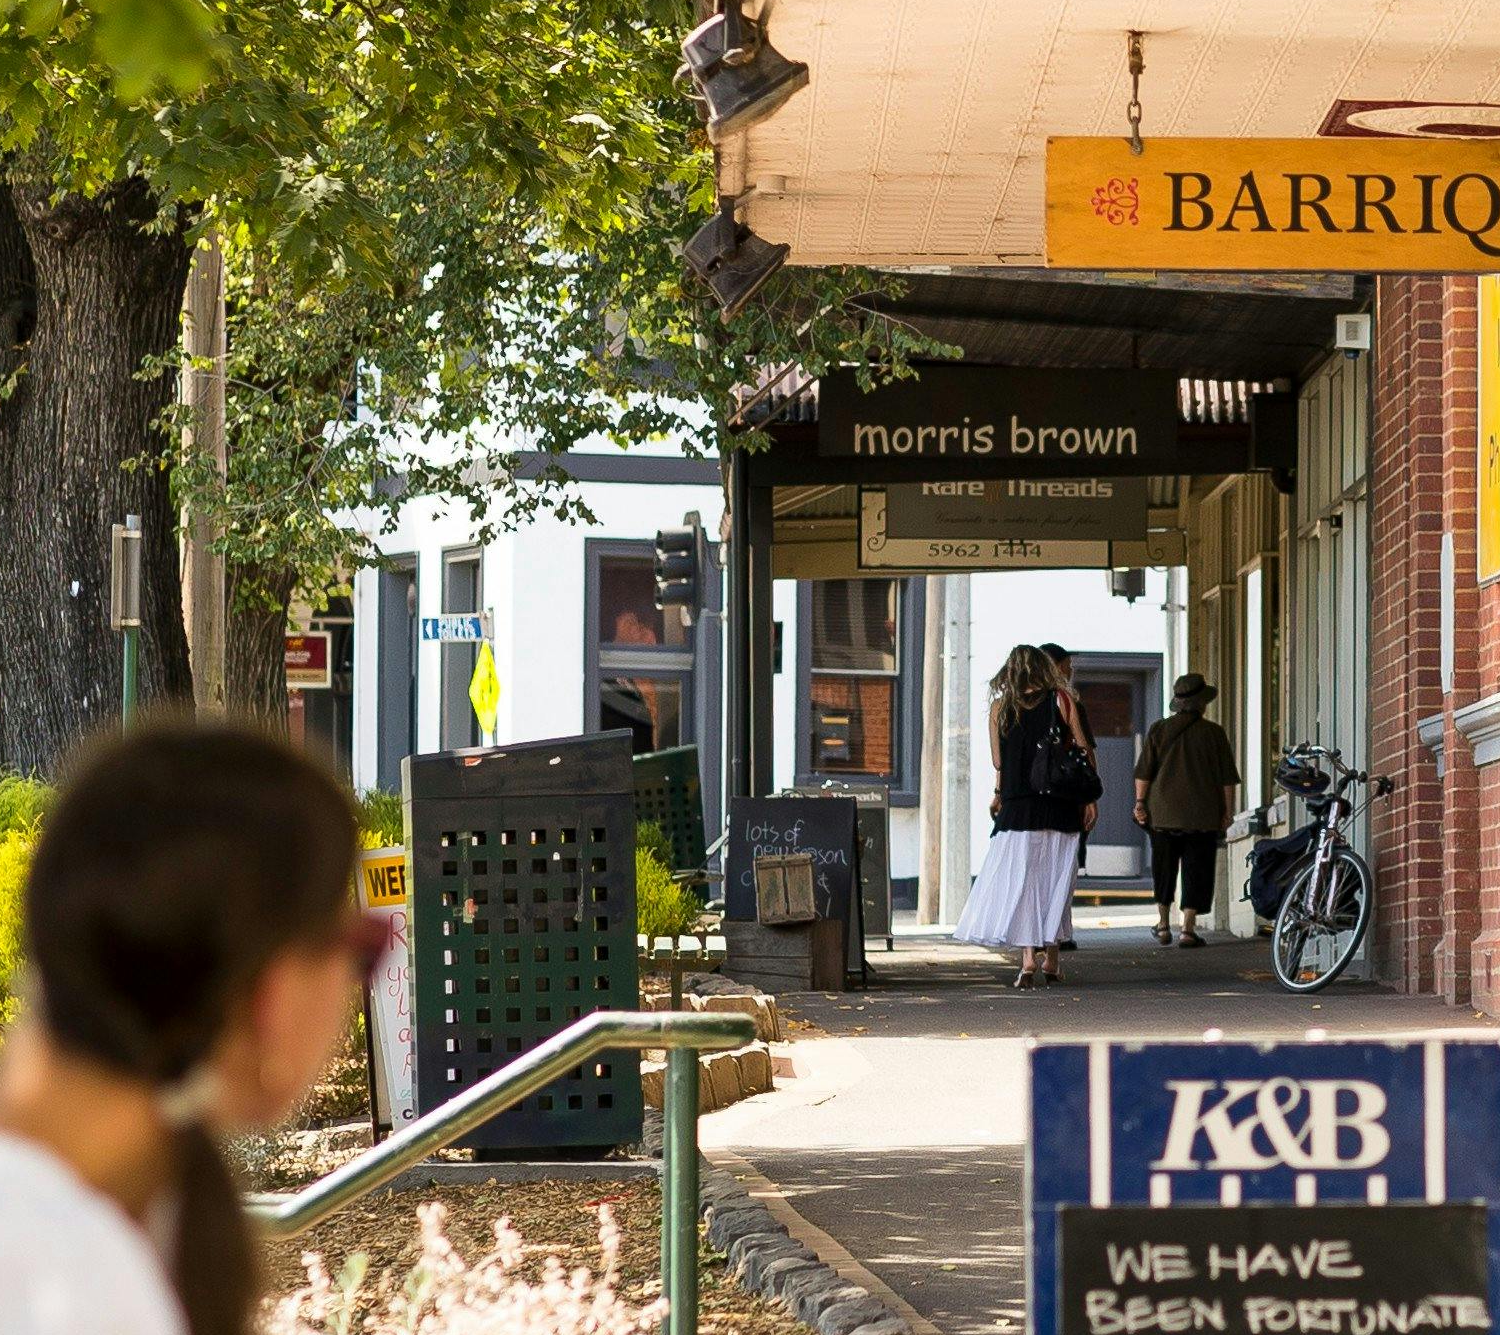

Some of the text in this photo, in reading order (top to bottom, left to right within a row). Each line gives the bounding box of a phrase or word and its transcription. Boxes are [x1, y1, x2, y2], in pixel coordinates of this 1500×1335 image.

[854, 415, 1137, 455] morris brown
[921, 478, 1113, 498] Rare Threads
[928, 543, 981, 559] 5962
[745, 819, 804, 845] lots of
[1149, 1076, 1390, 1172] K&B
[1107, 1240, 1363, 1281] WE HAVE
[1086, 1290, 1226, 1335] BEEN
